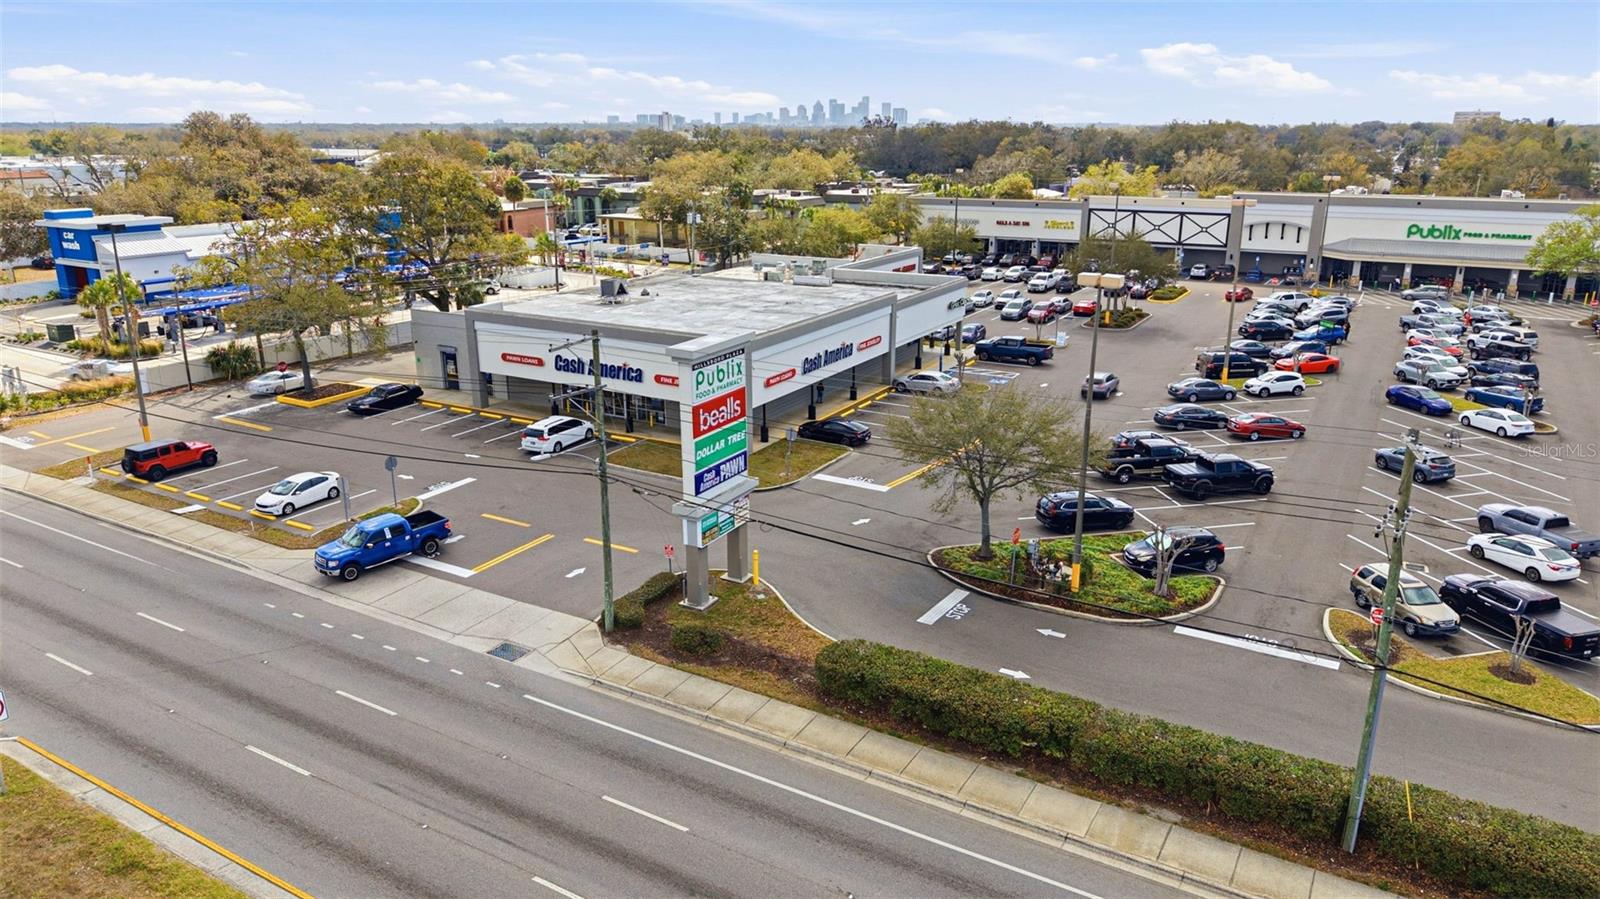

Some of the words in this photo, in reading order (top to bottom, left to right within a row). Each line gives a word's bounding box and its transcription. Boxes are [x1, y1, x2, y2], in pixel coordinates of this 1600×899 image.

[63, 231, 75, 239] car
[1407, 224, 1462, 240] Publix
[62, 240, 81, 250] wash
[554, 354, 585, 375] Cash
[694, 355, 725, 370] HILLSBORO
[726, 349, 743, 358] PLAZA
[802, 352, 822, 375] Cash
[823, 341, 854, 367] America
[695, 359, 743, 391] Publix
[696, 389, 710, 400] FOOD
[716, 376, 743, 392] PHARMACY
[699, 396, 742, 431] bealls
[696, 439, 726, 461] DOLLAR
[727, 430, 746, 446] TREE
[703, 469, 716, 482] Cash
[719, 454, 745, 482] PAWN
[945, 603, 971, 620] STOP
